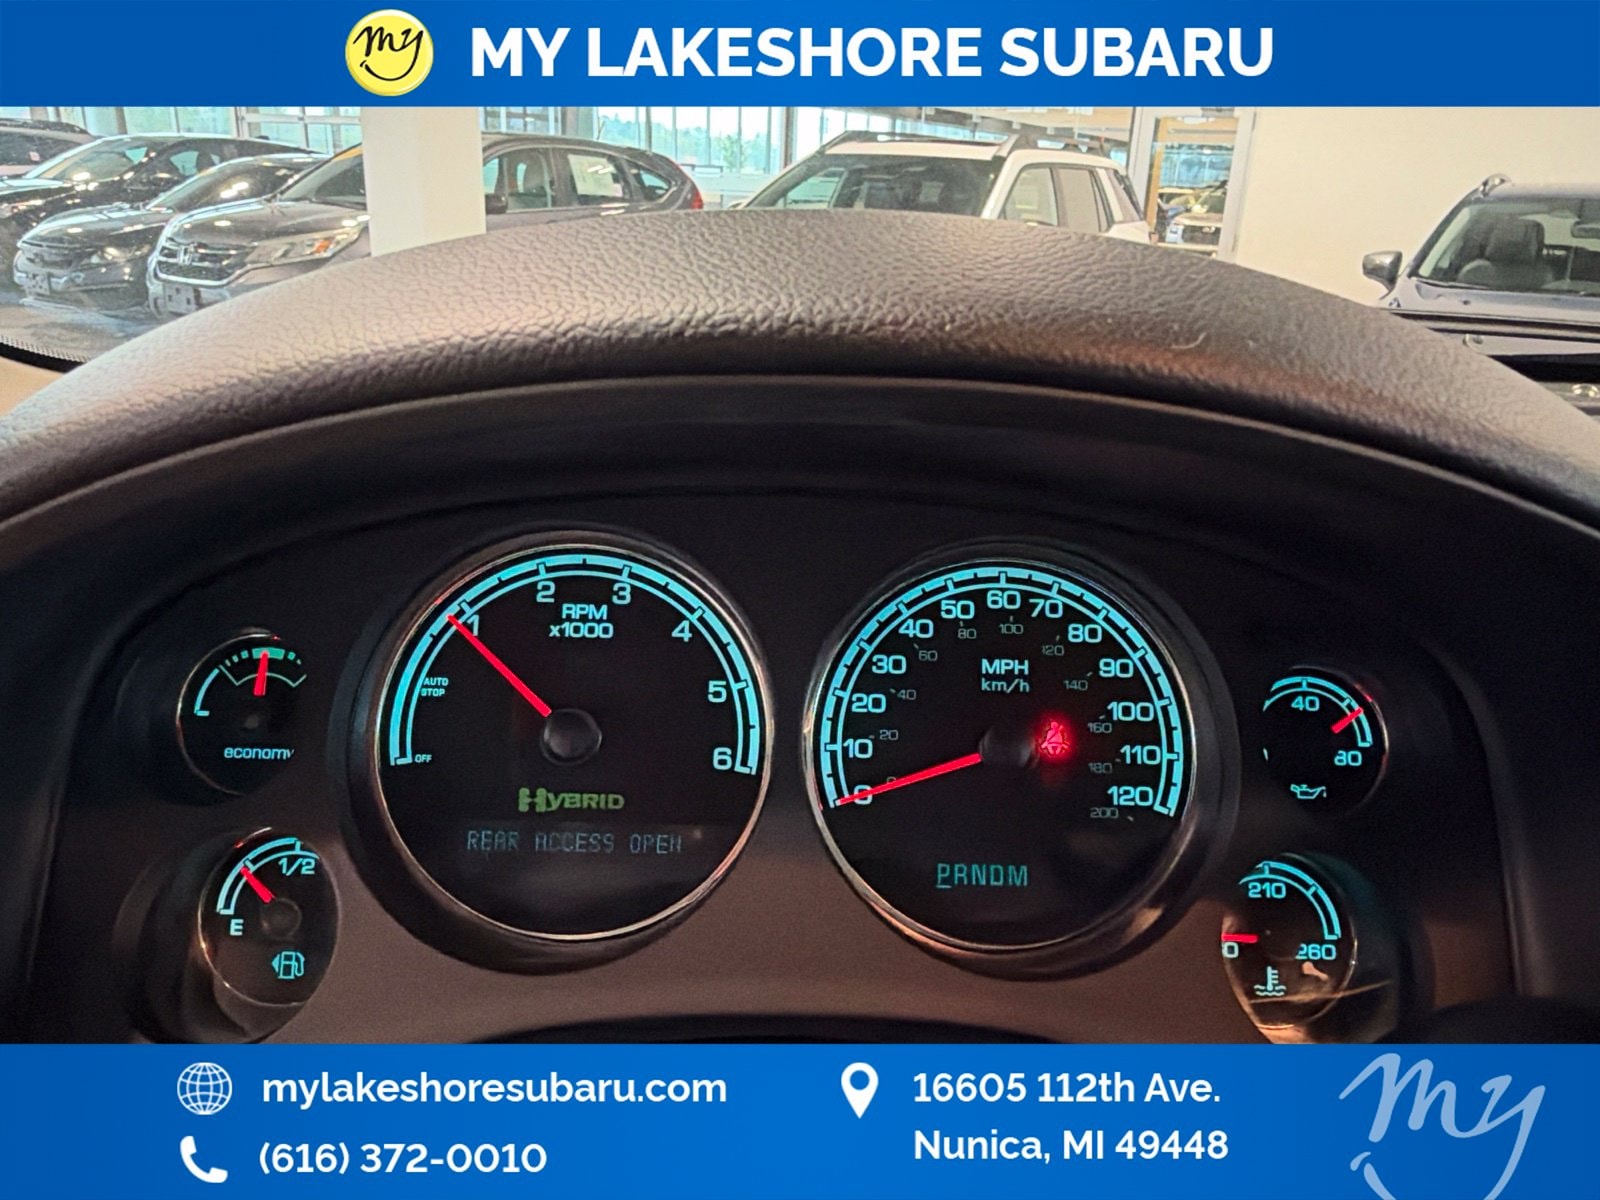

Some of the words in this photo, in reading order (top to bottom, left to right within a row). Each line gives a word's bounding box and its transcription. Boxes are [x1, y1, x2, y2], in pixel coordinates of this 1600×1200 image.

[536, 581, 556, 603] 2
[612, 581, 632, 604] 3
[987, 589, 1021, 610] 60
[561, 604, 607, 621] RPM
[940, 600, 974, 620] 50
[1029, 599, 1063, 619] 70
[466, 614, 480, 636] 1
[549, 622, 614, 639] x1000
[671, 620, 693, 642] 4
[898, 619, 933, 639] 40
[957, 628, 977, 640] 80
[999, 622, 1024, 636] 100
[1067, 623, 1103, 644] 80
[918, 648, 938, 662] 60
[1041, 643, 1066, 657] 120
[871, 654, 907, 675] 30
[981, 658, 1030, 676] MPH
[1099, 659, 1134, 679] 90
[423, 677, 449, 687] AUTO
[981, 677, 1030, 694] km/h
[1063, 679, 1089, 692] 140
[420, 687, 446, 698] STOP
[707, 680, 728, 703] 5
[896, 688, 917, 701] 40
[851, 692, 887, 714] 20
[1107, 702, 1154, 722] 100
[1291, 696, 1321, 712] 40
[878, 728, 899, 742] 20
[1087, 721, 1113, 734] 160
[843, 738, 873, 759] 10
[1120, 744, 1161, 765] 110
[414, 753, 433, 764] OFF
[712, 747, 733, 771] 6
[1333, 750, 1363, 767] 80
[1107, 785, 1155, 807] 120
[1090, 807, 1119, 819] 200
[466, 830, 519, 851] REAR
[534, 832, 615, 854] ACCESS
[629, 834, 683, 855] OPEN
[278, 858, 316, 876] 1/2
[1249, 883, 1288, 899] 210
[229, 918, 244, 936] E
[1295, 943, 1337, 960] 260
